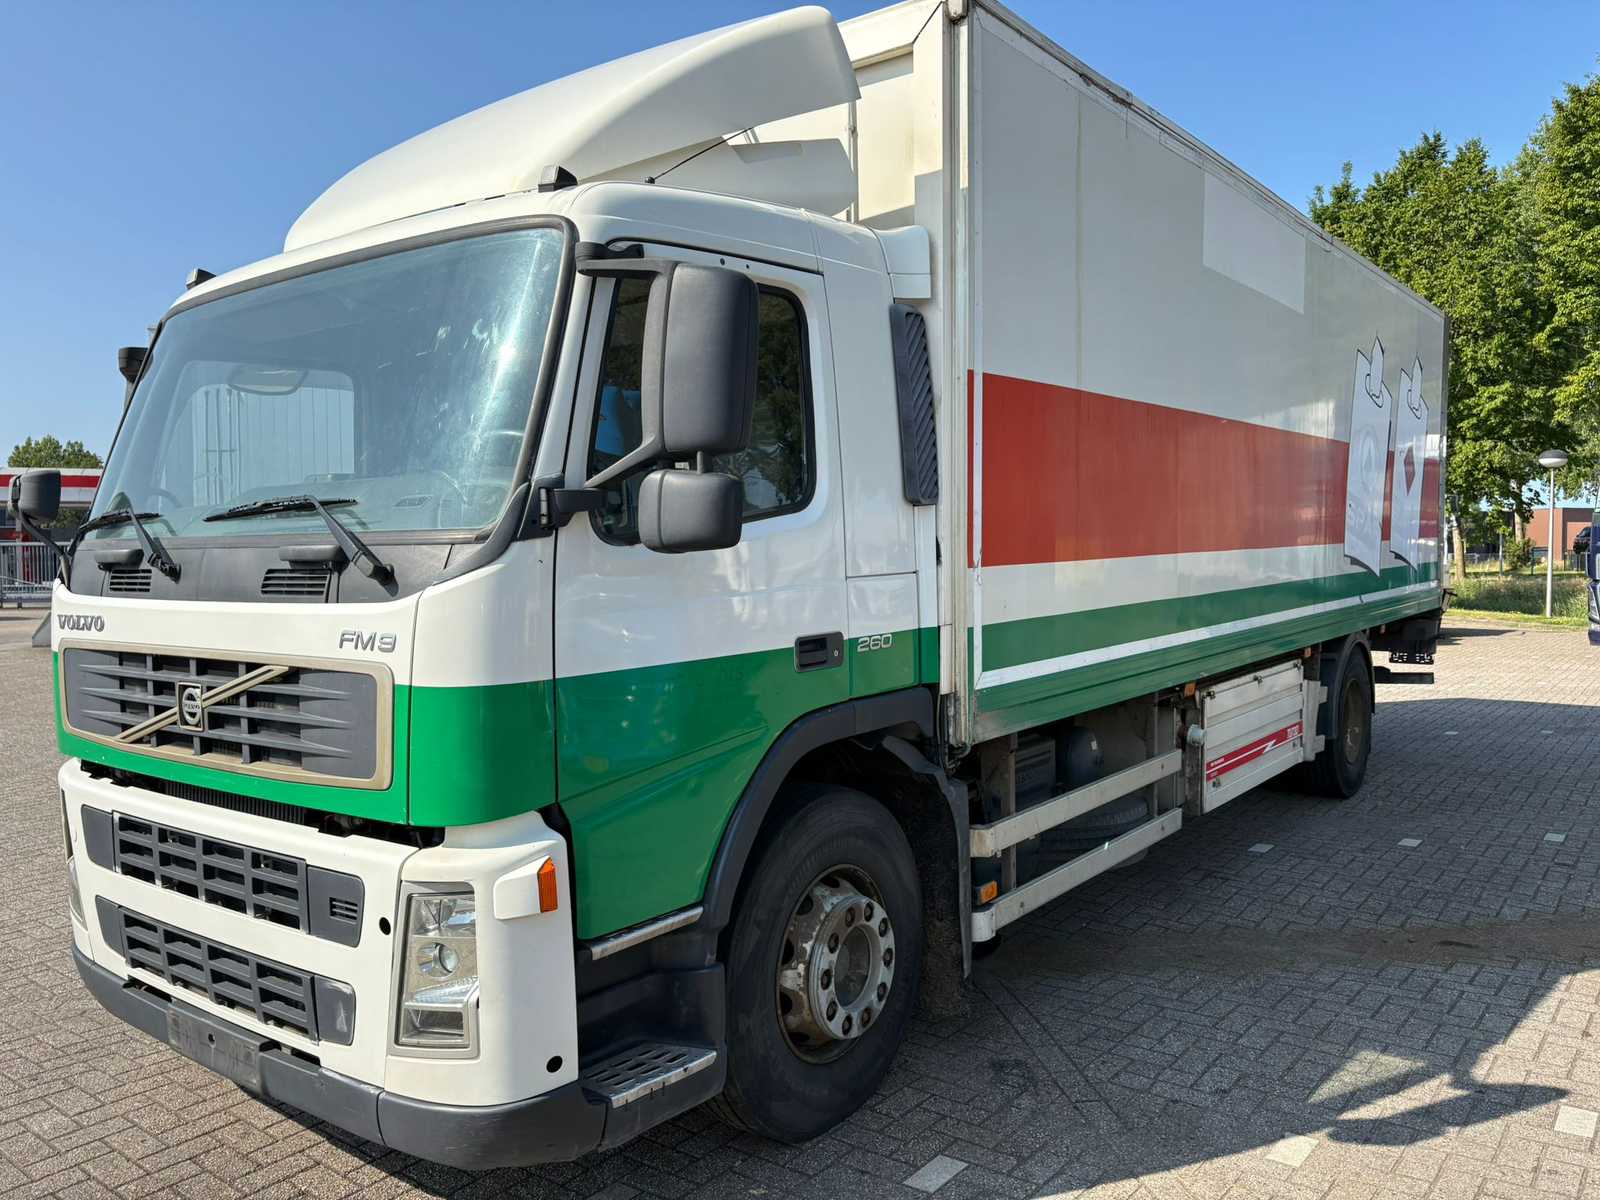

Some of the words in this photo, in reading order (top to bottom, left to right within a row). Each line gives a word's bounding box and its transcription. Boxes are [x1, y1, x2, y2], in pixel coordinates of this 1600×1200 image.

[57, 614, 105, 632] VOLVO
[339, 630, 397, 653] FM9
[857, 633, 892, 652] 260
